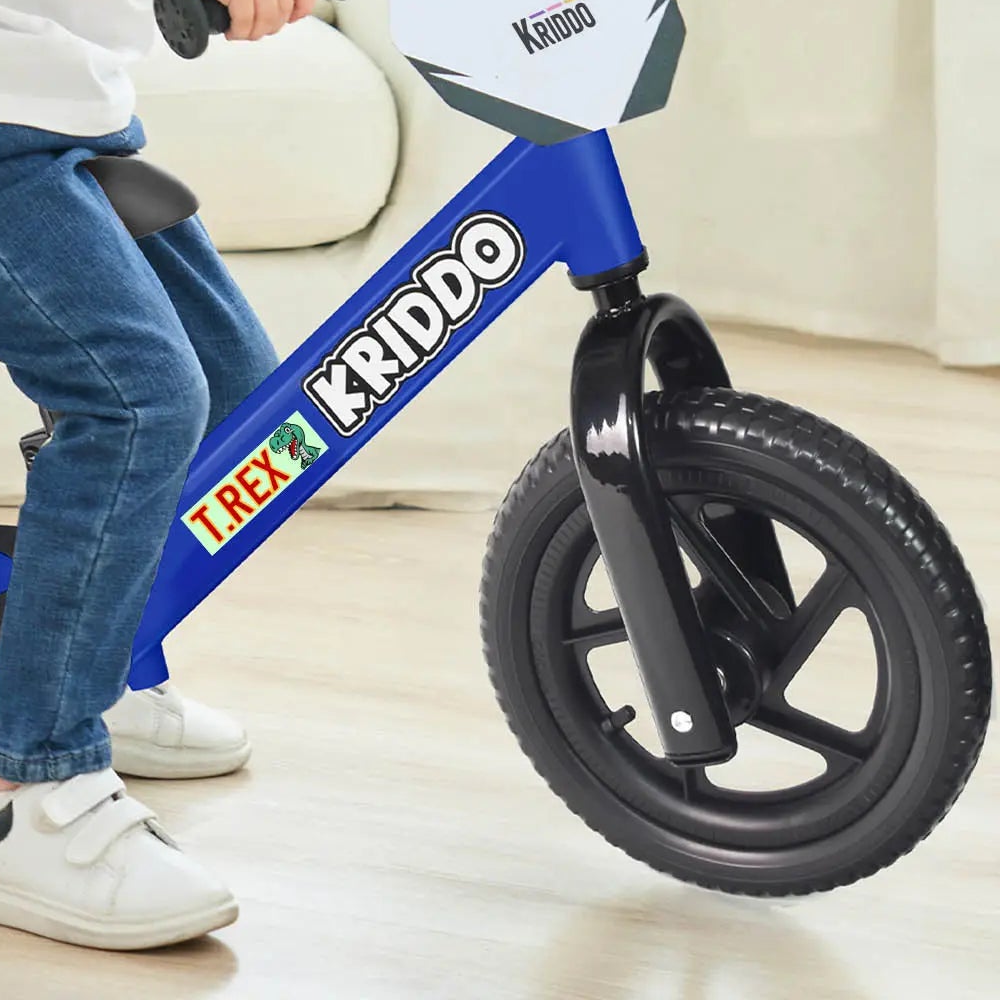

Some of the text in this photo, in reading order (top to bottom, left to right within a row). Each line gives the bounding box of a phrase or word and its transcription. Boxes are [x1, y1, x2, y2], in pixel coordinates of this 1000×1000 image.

[511, 1, 597, 55] KRIDDO
[308, 216, 520, 432] KRIDDO
[189, 447, 291, 545] T.REX
